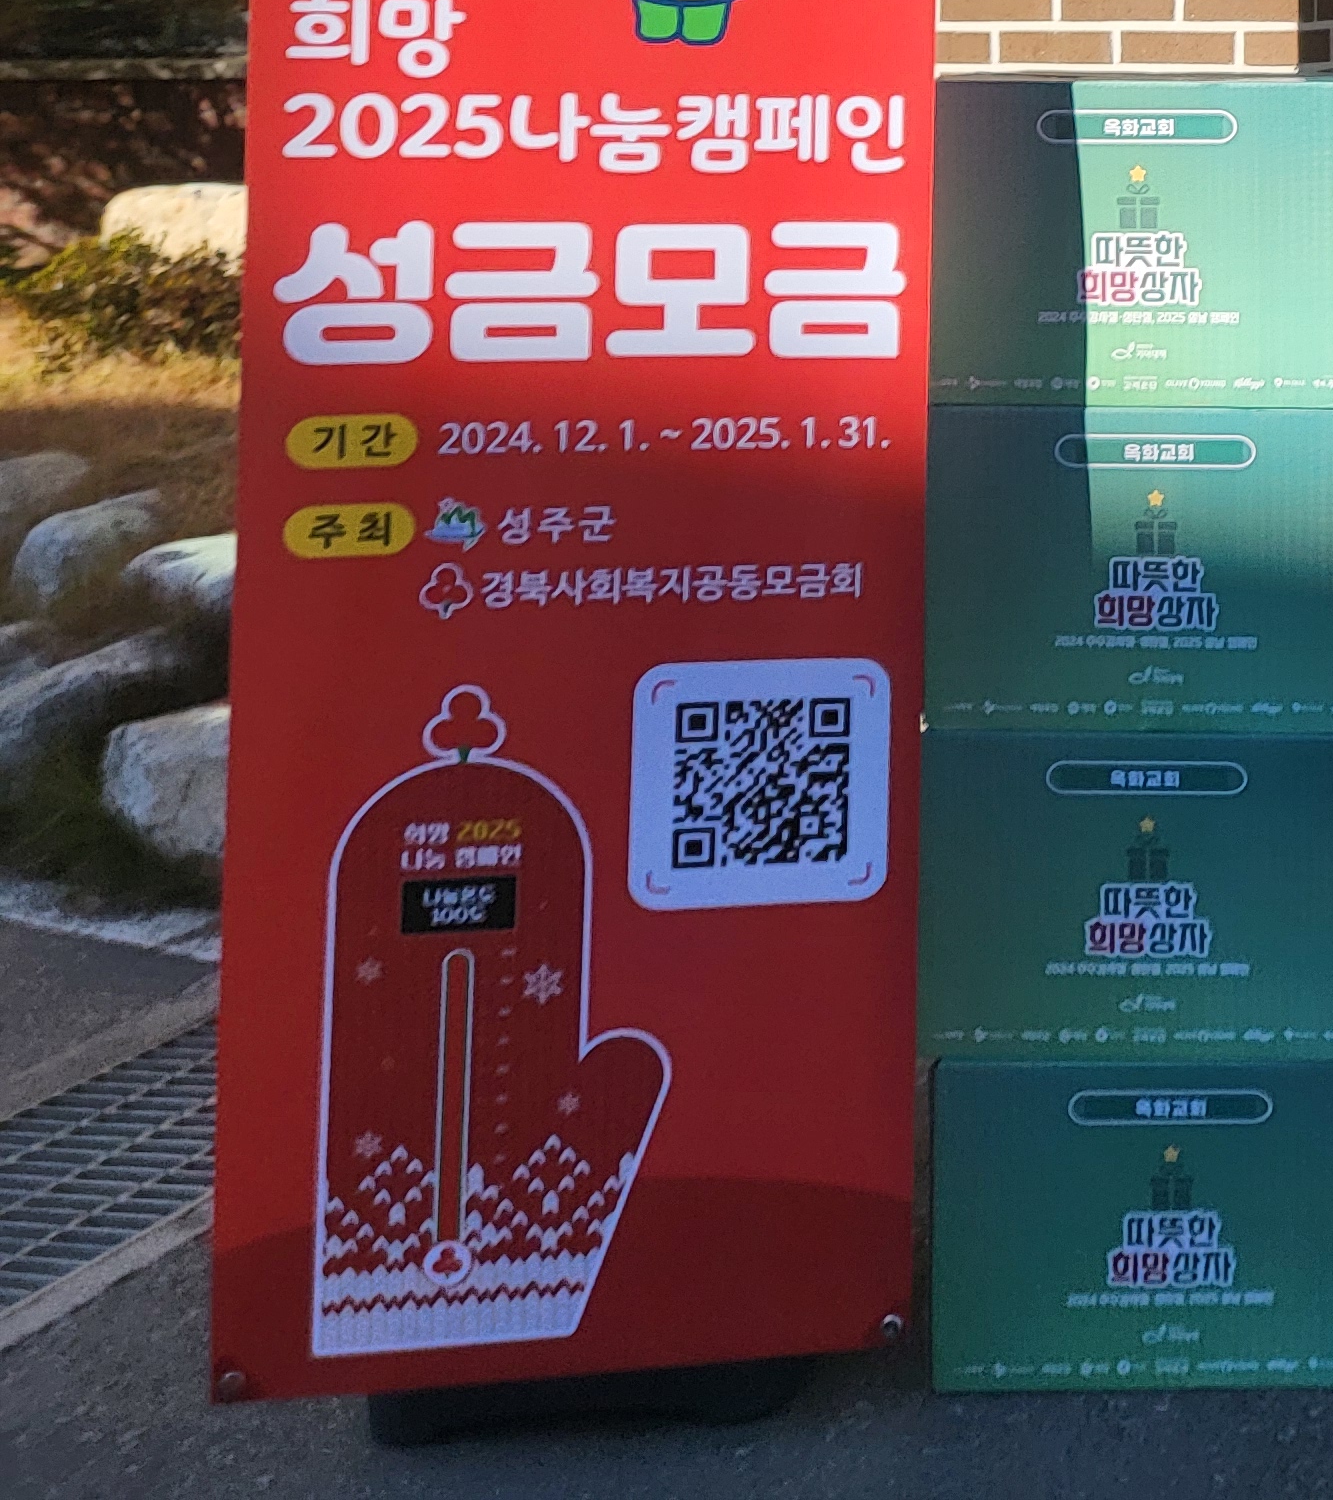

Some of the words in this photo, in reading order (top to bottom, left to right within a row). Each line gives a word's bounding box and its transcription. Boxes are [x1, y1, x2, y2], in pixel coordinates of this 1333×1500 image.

[282, 92, 906, 174] 2025나눔캠페인
[1103, 118, 1174, 137] 옥화교회
[1094, 235, 1185, 268] 따뜻한
[273, 219, 907, 366] 성금모금
[1080, 269, 1199, 303] 희망상자
[1156, 310, 1185, 324] 2025
[313, 422, 398, 458] 기간
[438, 422, 541, 455] 2024.
[554, 421, 607, 453] 12.
[620, 420, 650, 452] 1.
[690, 417, 790, 450] 2025.
[801, 417, 829, 449] 1.
[838, 416, 891, 448] 31.
[1123, 444, 1195, 463] 옥화교회
[308, 512, 393, 549] 주최
[498, 505, 616, 543] 성주군
[481, 563, 863, 609] 경북사회복지공동모금회
[1112, 560, 1201, 592] 따뜻한
[1098, 594, 1217, 628] 희망상자
[456, 819, 522, 842] 2025
[1103, 886, 1195, 919] 따뜻한
[1088, 921, 1209, 954] 희망상자
